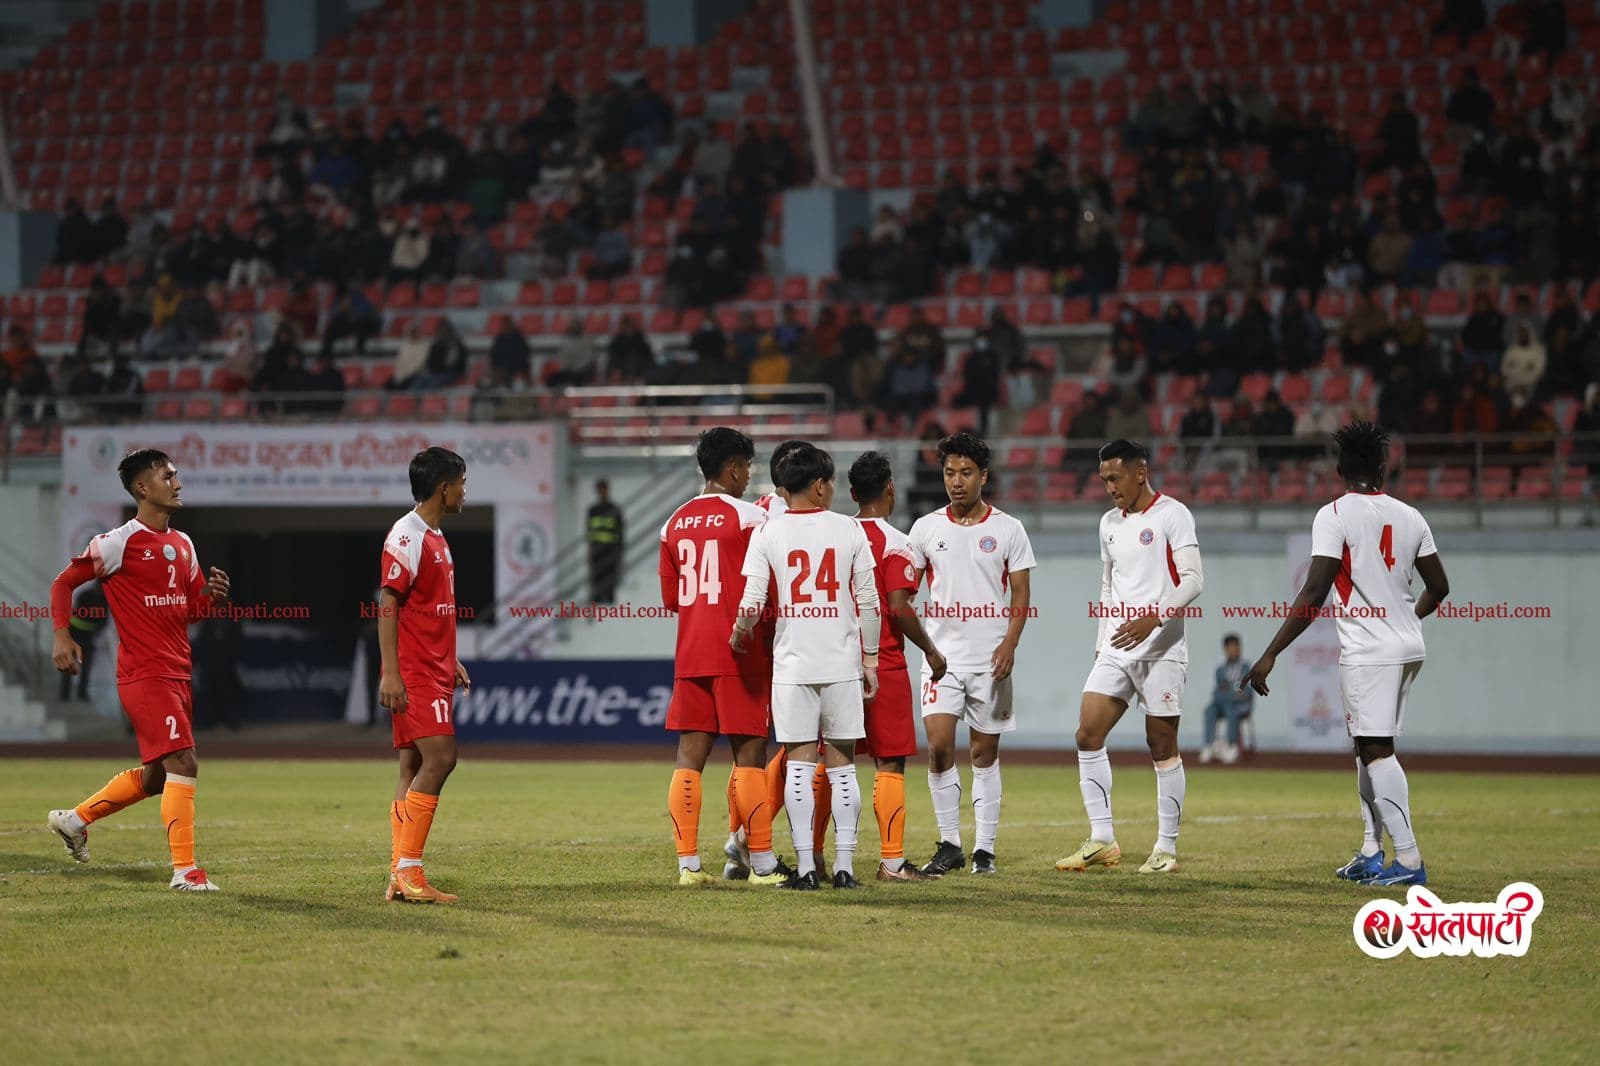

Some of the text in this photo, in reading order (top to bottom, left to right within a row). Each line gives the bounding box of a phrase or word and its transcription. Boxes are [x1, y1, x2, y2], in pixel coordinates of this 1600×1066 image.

[674, 514, 725, 531] APF FC
[1379, 524, 1395, 572] 4
[168, 564, 177, 588] 2
[677, 538, 721, 607] 34
[787, 548, 840, 605] 24
[453, 675, 673, 727] ww.the-a
[922, 681, 939, 706] 25
[431, 698, 449, 724] 17
[165, 715, 180, 740] 2
